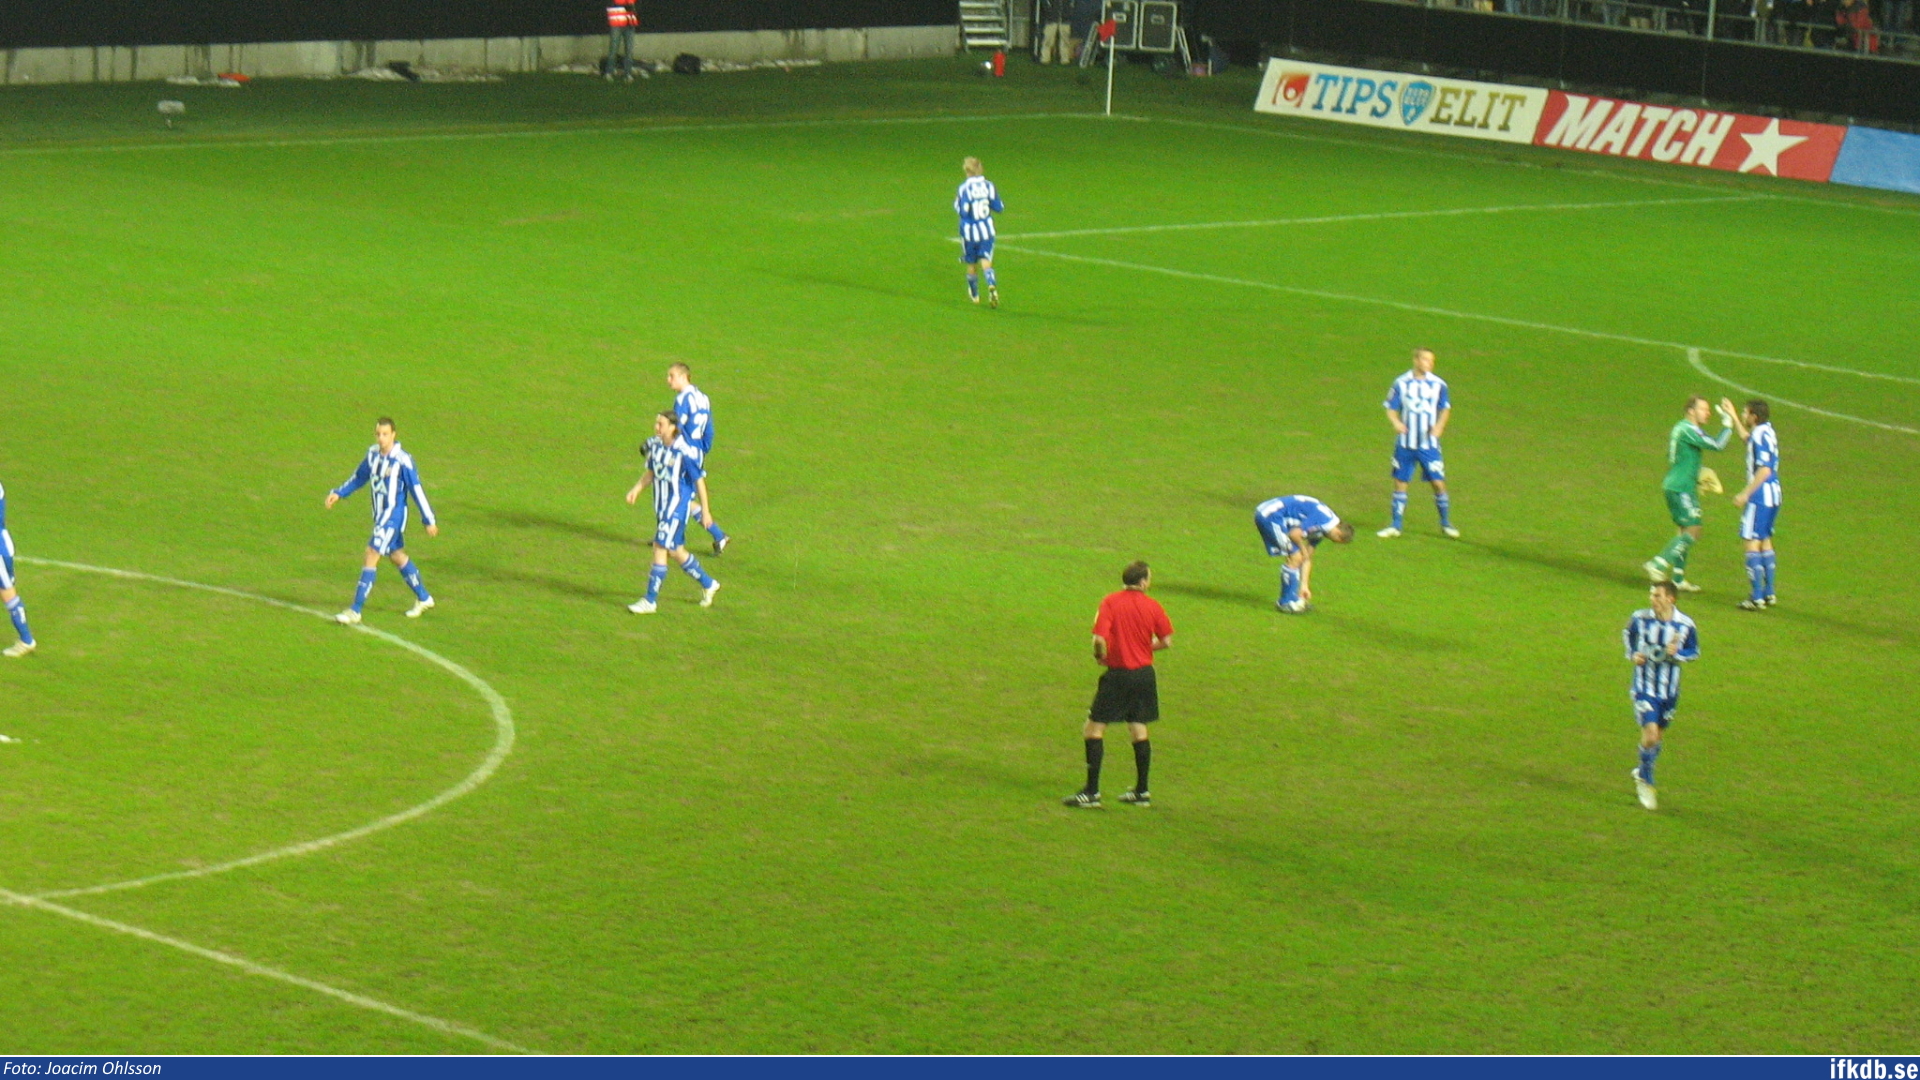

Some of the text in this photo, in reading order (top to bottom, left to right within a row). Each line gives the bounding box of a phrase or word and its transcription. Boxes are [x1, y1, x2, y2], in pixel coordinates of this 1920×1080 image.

[1312, 73, 1398, 118] TIPS
[1429, 87, 1527, 131] ELIT
[1544, 94, 1735, 166] MATCH
[971, 199, 990, 220] 16
